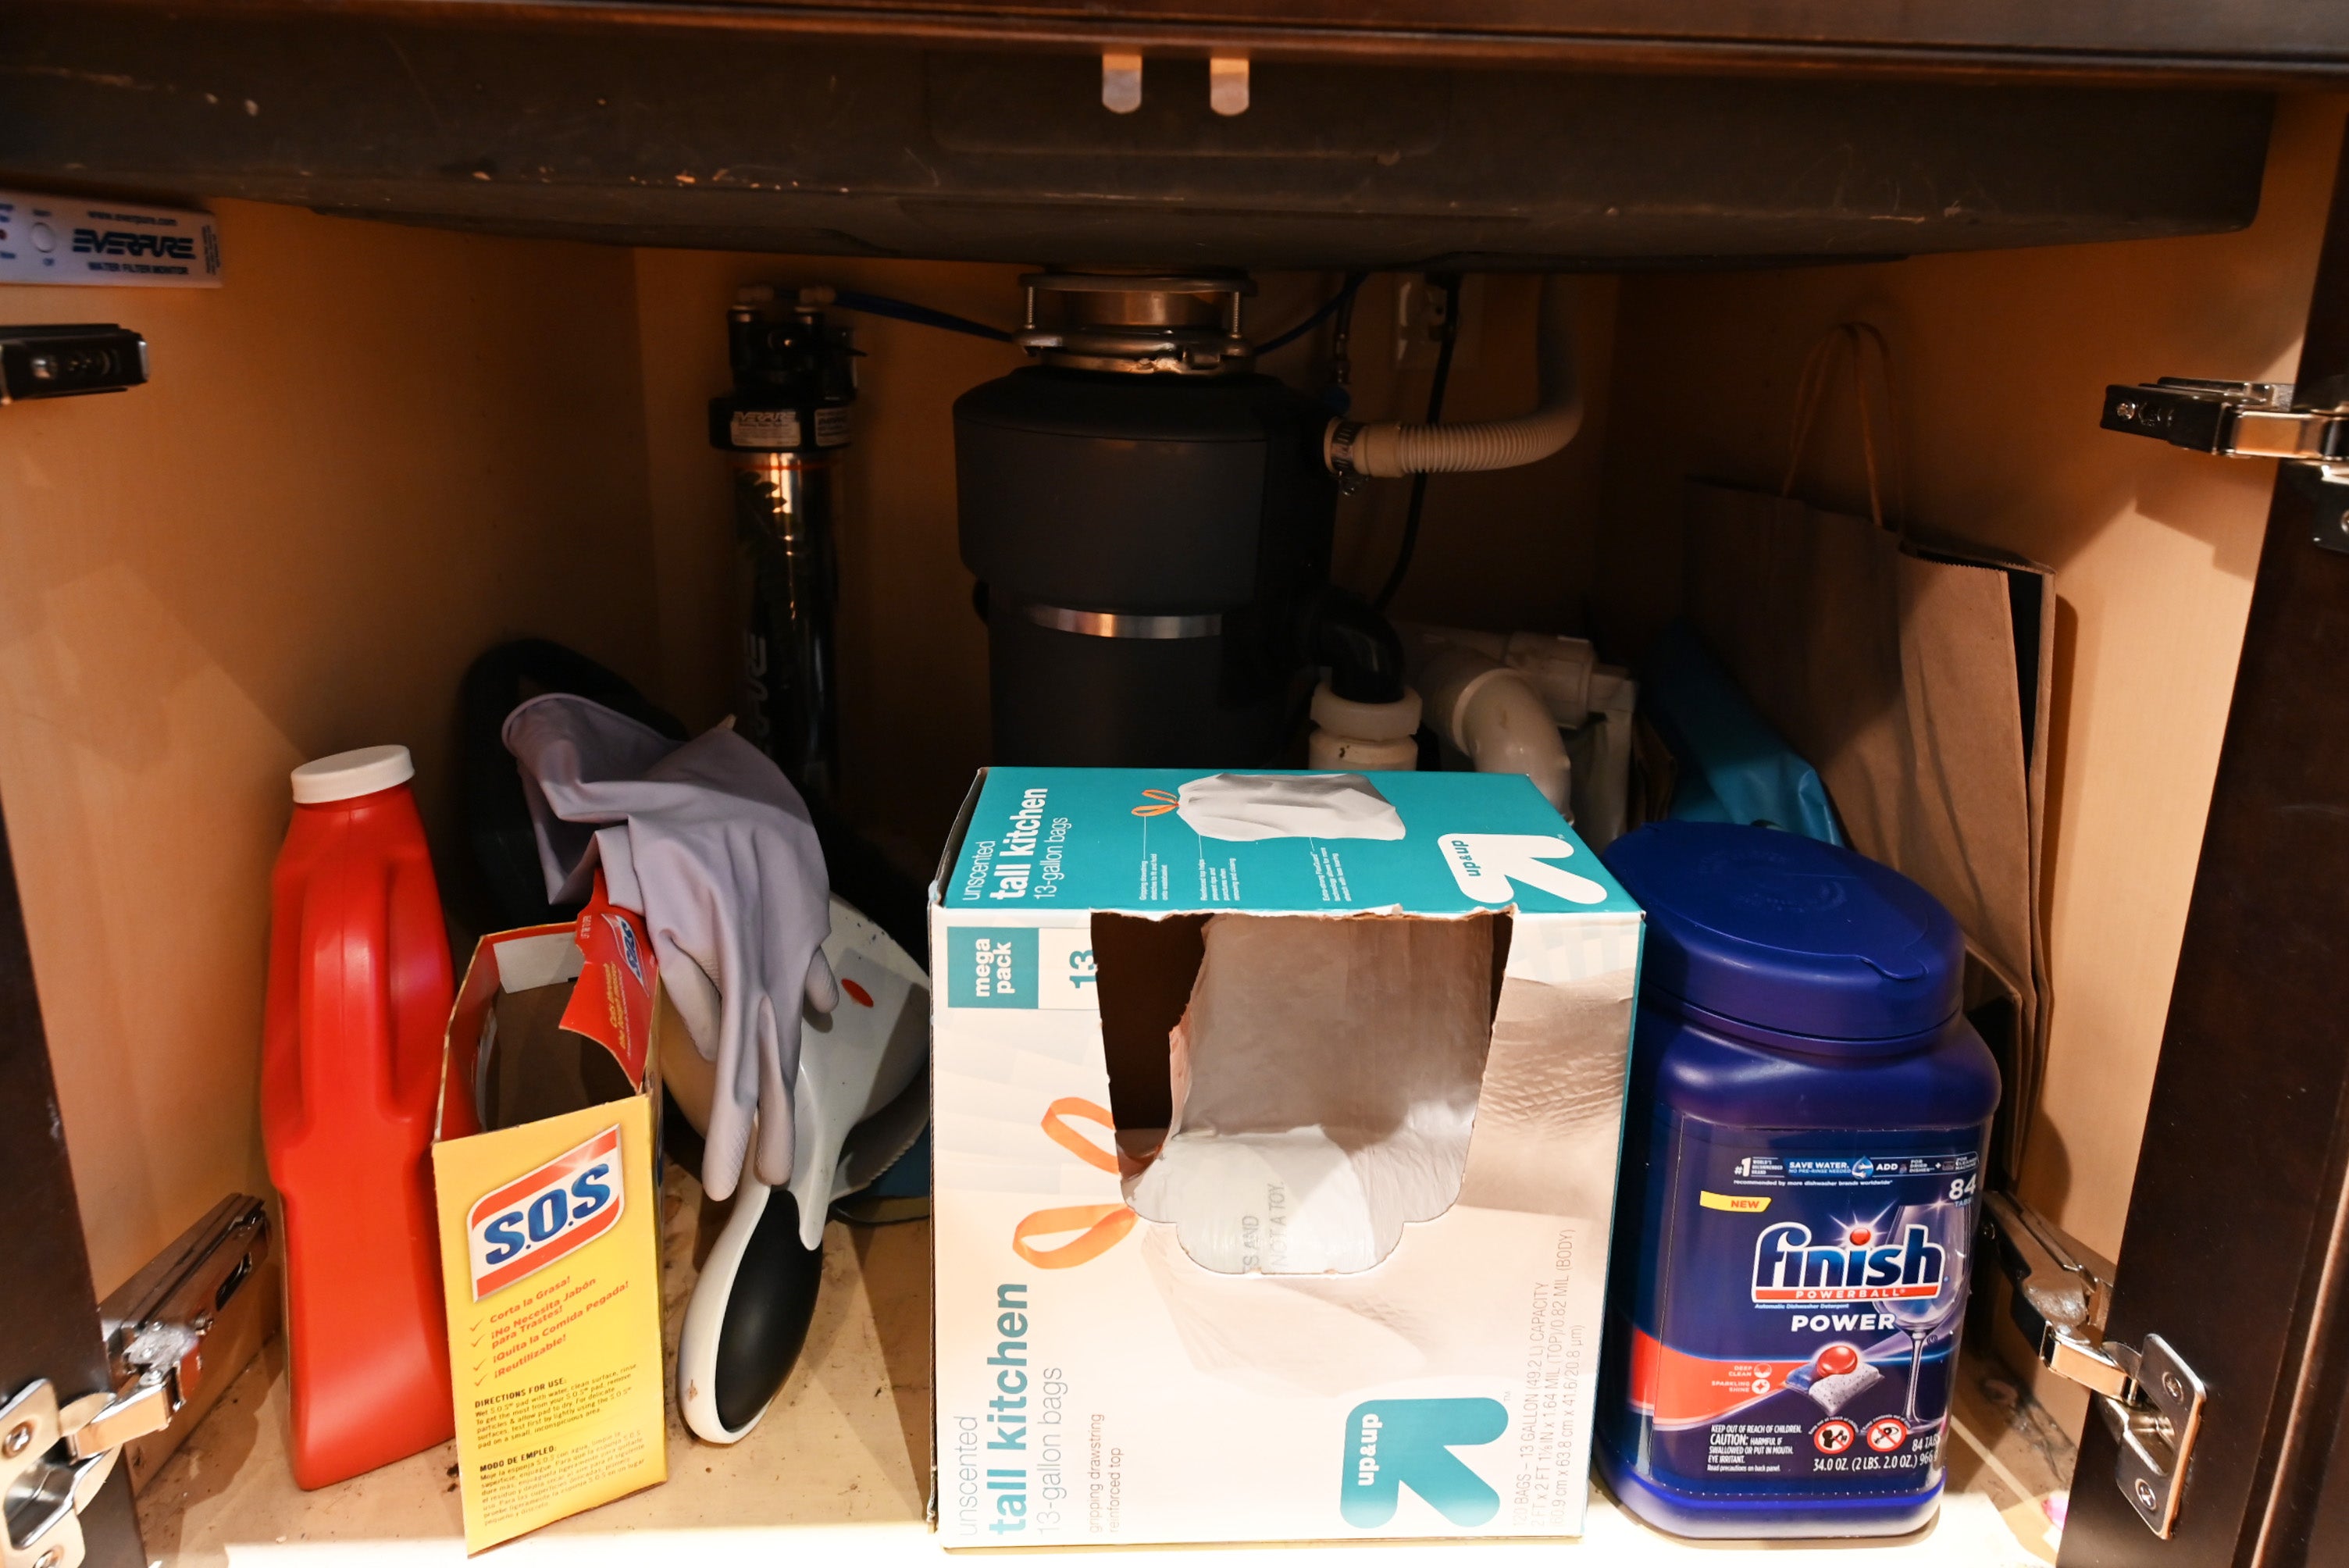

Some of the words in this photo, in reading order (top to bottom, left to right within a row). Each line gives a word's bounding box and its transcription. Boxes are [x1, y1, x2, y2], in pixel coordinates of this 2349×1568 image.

[72, 228, 196, 260] EVERPURE
[123, 263, 152, 273] FILTER
[999, 788, 1048, 857] kitchen
[1043, 817, 1072, 843] bags
[962, 840, 996, 900] unscented
[1033, 846, 1065, 900] 13-gallon
[1451, 839, 1481, 877] up&up
[989, 864, 1032, 900] tall
[975, 938, 995, 997] mega
[993, 941, 1015, 994] pack
[1734, 1156, 1752, 1178] #1
[1876, 1163, 1898, 1171] ADD
[1948, 1173, 1977, 1201] 84
[484, 1164, 611, 1265] S.O.S
[1731, 1199, 1760, 1209] NEW
[1242, 1215, 1260, 1250] AND
[1269, 1215, 1286, 1227] A
[1269, 1228, 1288, 1267] NOT
[1555, 1228, 1575, 1271] (BODY)
[1754, 1224, 1943, 1288] finish
[490, 1304, 520, 1322] Corta
[523, 1297, 533, 1307] la
[536, 1277, 570, 1300] Grasa!
[1552, 1274, 1570, 1298] MIL
[491, 1325, 510, 1338] ¡No
[514, 1299, 559, 1327] Necesita
[563, 1278, 595, 1301] Jabón
[529, 1333, 539, 1345] la
[542, 1310, 583, 1336] Comida
[586, 1280, 628, 1313] Pegada!
[1528, 1281, 1549, 1342] CAPACITY
[1791, 1313, 1897, 1332] POWER
[492, 1334, 515, 1349] para
[520, 1305, 562, 1335] Trastes!
[986, 1283, 1028, 1450] kitchen
[1524, 1360, 1543, 1390] (49.2
[1544, 1367, 1561, 1389] MIL
[1561, 1350, 1581, 1407] 41.6/20.8
[475, 1389, 526, 1408] DIRECTIONS
[529, 1383, 545, 1394] FOR
[1036, 1367, 1068, 1425] bags
[1542, 1392, 1557, 1417] 1.64
[512, 1407, 529, 1416] most
[538, 1408, 551, 1417] pad
[1520, 1393, 1540, 1442] GALLON
[1540, 1431, 1555, 1443] IN
[1560, 1419, 1574, 1438] cm
[1710, 1434, 1748, 1445] CAUTION:
[1750, 1437, 1776, 1445] HARMFUL
[1711, 1424, 1726, 1433] KEEP
[1727, 1424, 1738, 1433] OUT
[1738, 1424, 1746, 1433] OF
[1747, 1424, 1765, 1433] REACH
[1766, 1424, 1773, 1433] OF
[1773, 1424, 1802, 1434] CHILDREN.
[1086, 1413, 1104, 1480] drawstring
[1107, 1447, 1124, 1467] top
[1357, 1413, 1382, 1486] up&up
[1519, 1445, 1535, 1458] 13
[1554, 1440, 1572, 1467] 63.8
[1753, 1446, 1765, 1455] PUT
[1912, 1438, 1923, 1452] 84
[479, 1461, 504, 1471] MODO
[953, 1416, 978, 1538] unscented
[1535, 1466, 1550, 1481] FT
[1813, 1458, 1834, 1472] 34.0
[1834, 1458, 1848, 1471] OZ.
[1852, 1457, 1862, 1473] (2
[1862, 1457, 1880, 1470] LBS.
[1883, 1456, 1898, 1470] 2.0
[1899, 1454, 1917, 1469] OZ.)
[1919, 1451, 1933, 1465] 966
[1035, 1433, 1068, 1536] 13-gallon
[1513, 1474, 1531, 1505] BAGS
[1555, 1480, 1568, 1497] cm
[986, 1468, 1028, 1536] tall
[1086, 1483, 1104, 1533] gripping
[1107, 1472, 1121, 1533] reinforced
[1532, 1502, 1547, 1517] FT
